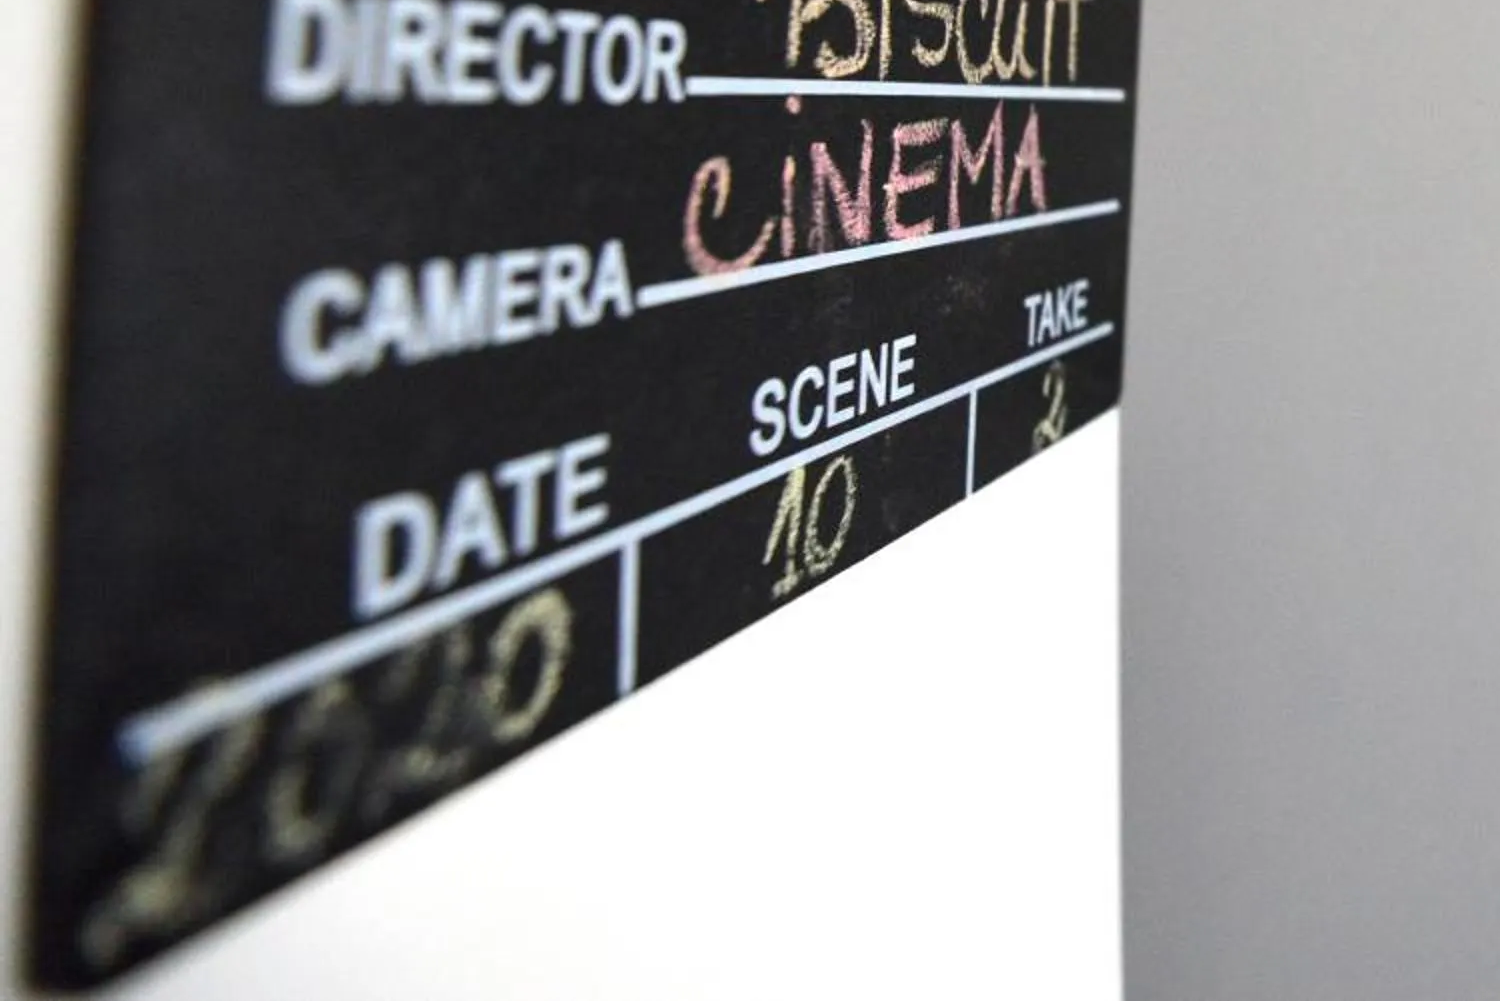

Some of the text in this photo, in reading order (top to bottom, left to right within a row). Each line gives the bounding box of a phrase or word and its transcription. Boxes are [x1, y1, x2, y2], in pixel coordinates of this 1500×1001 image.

[280, 241, 632, 383] CAMERA
[1024, 279, 1090, 348] TAKE
[748, 335, 917, 458] SCENE
[1031, 360, 1068, 454] 2
[352, 435, 612, 619] DATE
[762, 455, 857, 599] 10
